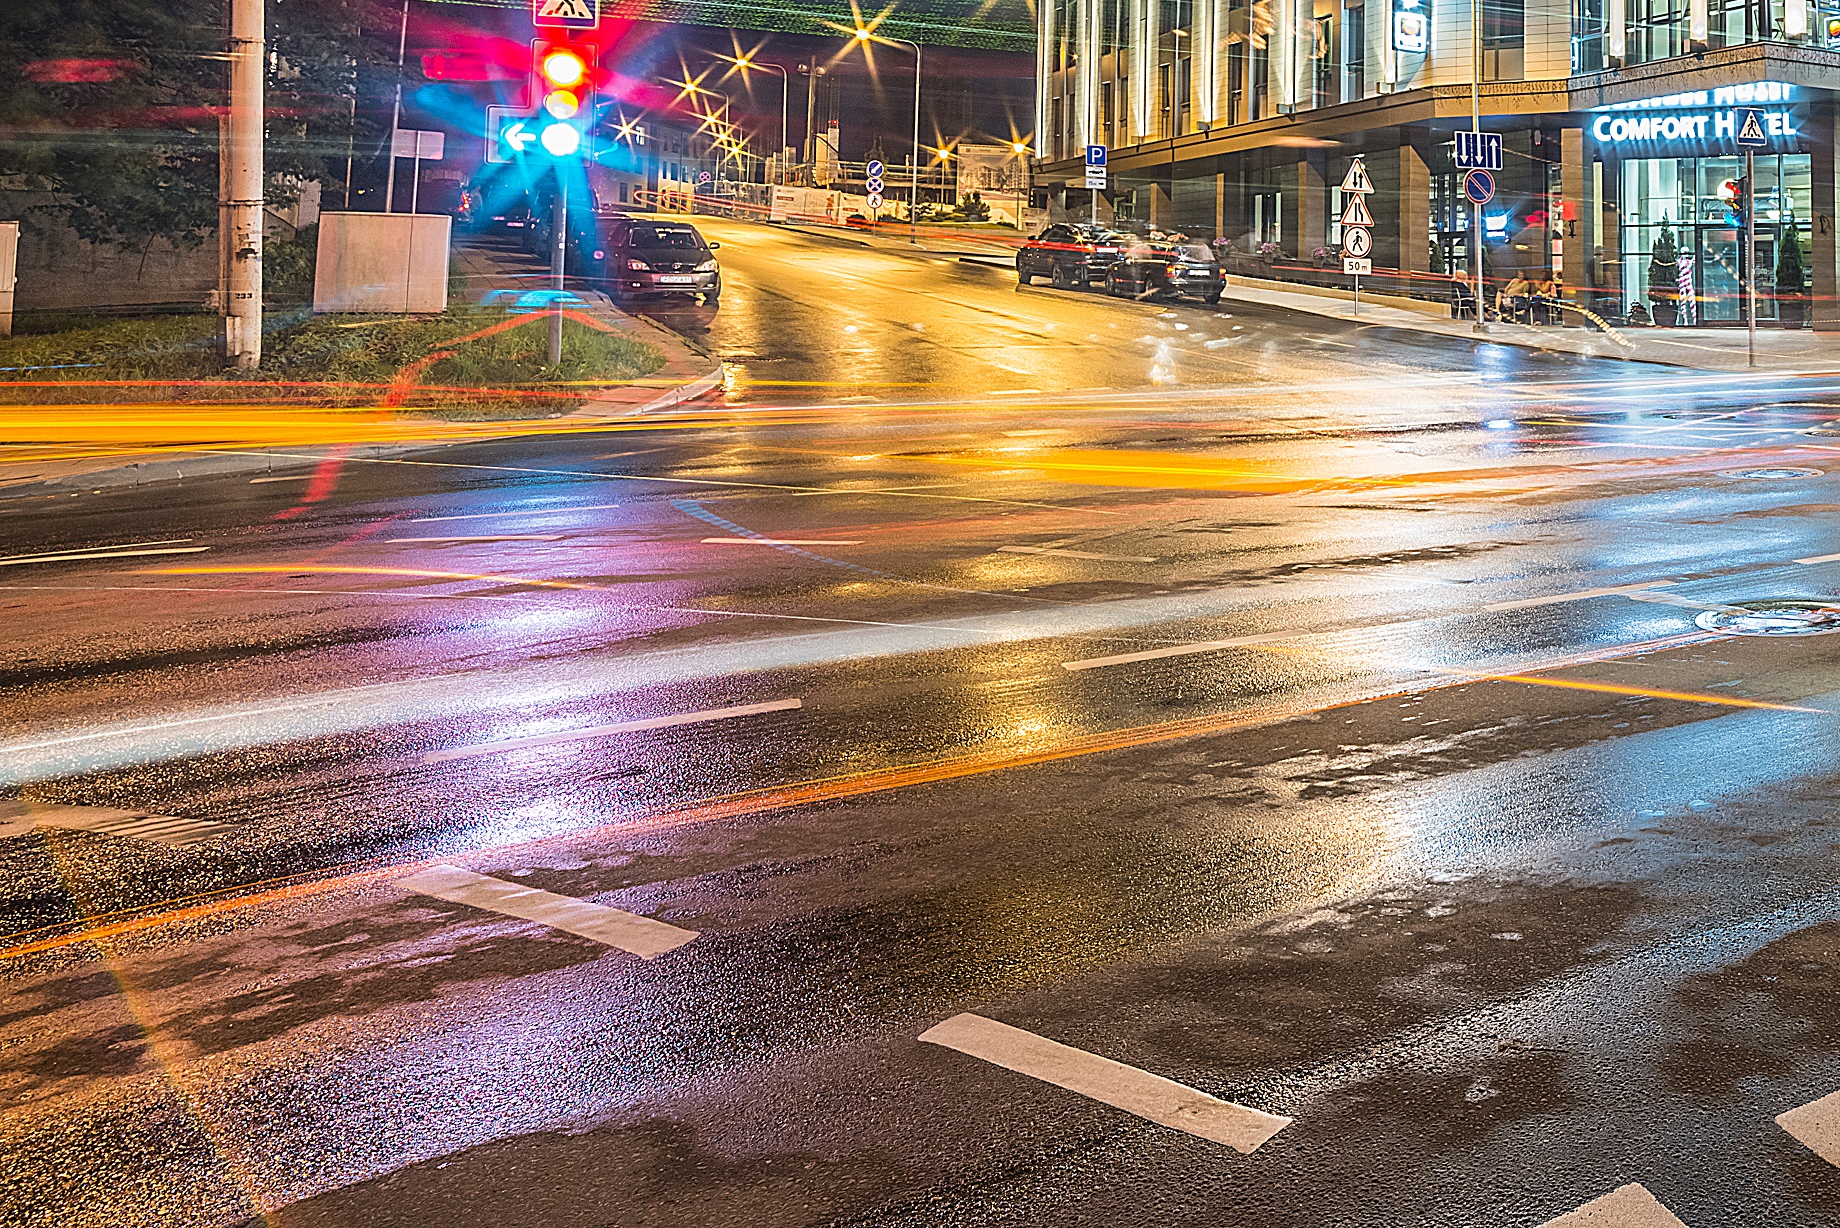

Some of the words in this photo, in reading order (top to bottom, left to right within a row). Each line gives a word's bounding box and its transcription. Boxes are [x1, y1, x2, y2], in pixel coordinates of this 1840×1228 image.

[1592, 114, 1709, 142] COMFORT
[1714, 110, 1797, 138] HEL
[1091, 147, 1103, 163] P
[1348, 261, 1360, 271] 50
